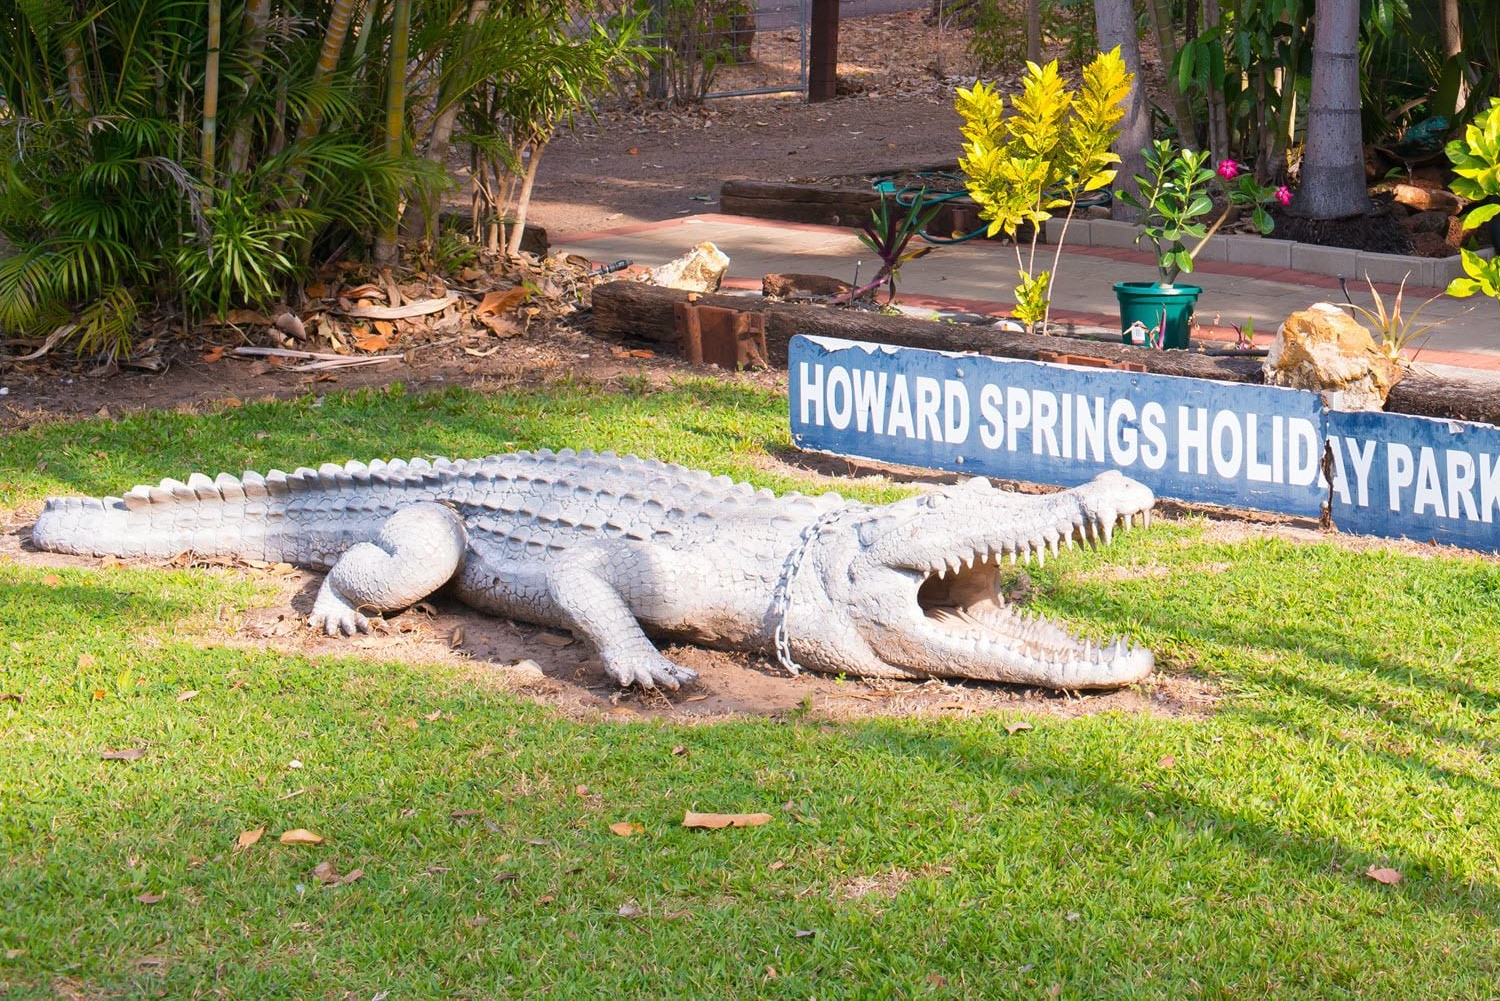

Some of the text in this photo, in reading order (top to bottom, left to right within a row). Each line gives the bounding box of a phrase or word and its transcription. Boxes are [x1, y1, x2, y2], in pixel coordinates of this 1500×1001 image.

[799, 361, 969, 445] HOWARD
[979, 383, 1168, 470] SPRINGS
[1177, 405, 1379, 508] HOLIDAY
